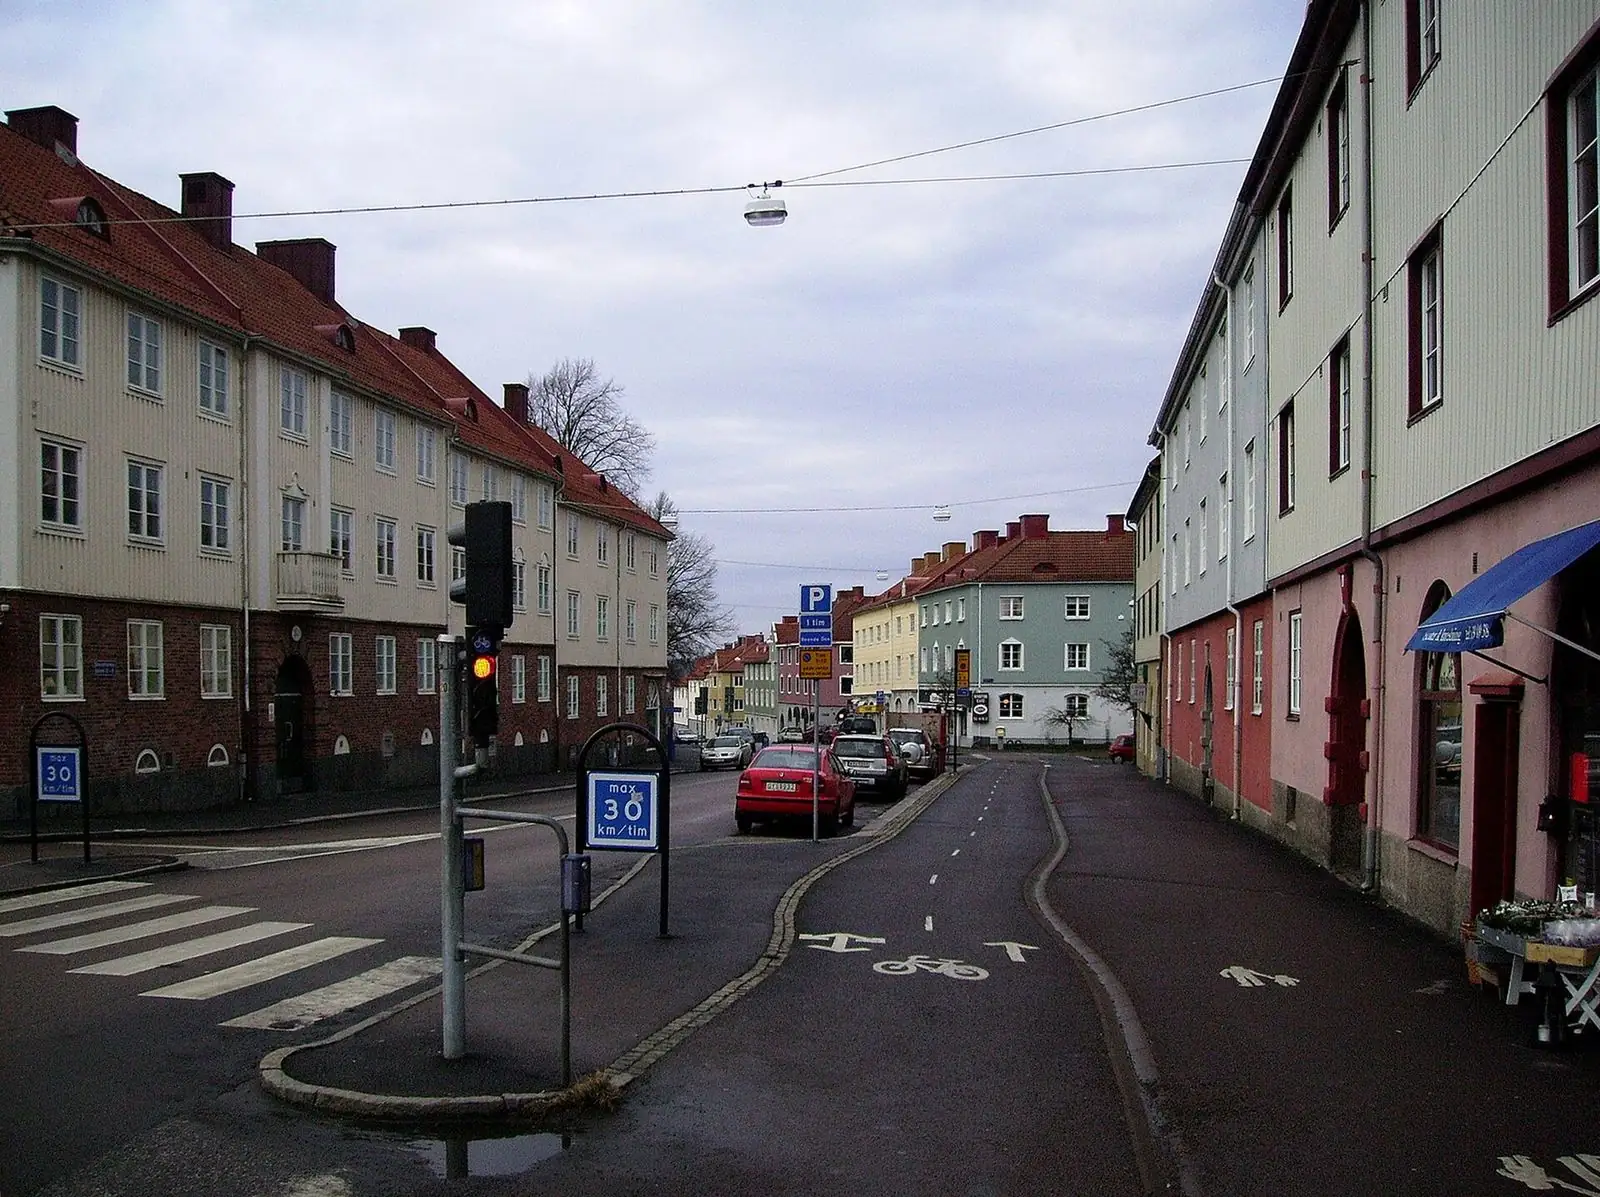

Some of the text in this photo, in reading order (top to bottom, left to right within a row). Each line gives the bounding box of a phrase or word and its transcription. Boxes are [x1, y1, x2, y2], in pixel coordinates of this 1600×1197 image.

[809, 587, 824, 611] P
[47, 766, 71, 781] 30
[43, 784, 75, 793] km/tim
[609, 784, 637, 794] max
[603, 799, 641, 821] 30
[597, 823, 647, 837] km/tim
